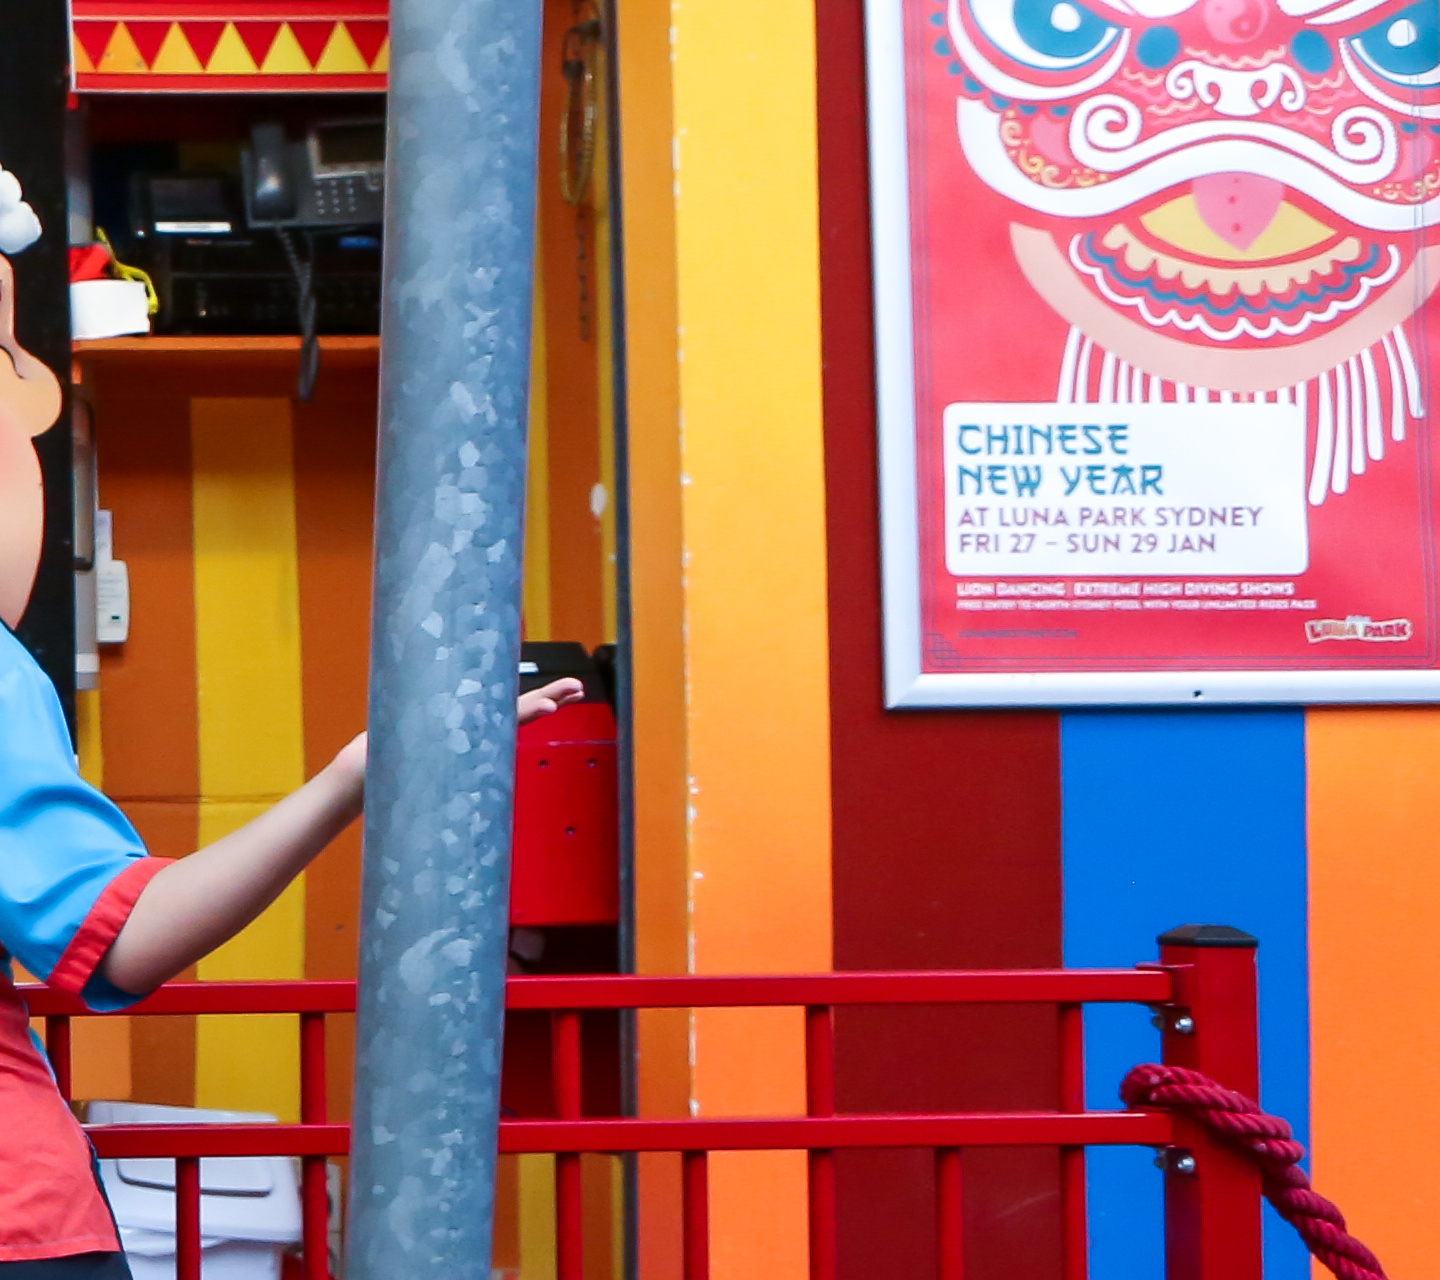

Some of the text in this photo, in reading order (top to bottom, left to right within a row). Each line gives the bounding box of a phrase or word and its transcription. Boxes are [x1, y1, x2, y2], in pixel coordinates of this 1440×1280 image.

[956, 423, 1130, 457] CHINESE
[956, 463, 1165, 498] NEW YEAR
[957, 506, 1264, 527] AT LUNA PARK SYDNEY
[958, 533, 1000, 554] FRI
[1008, 533, 1037, 554] 27
[1066, 533, 1121, 554] SUN
[1130, 533, 1159, 554] 29
[1166, 533, 1217, 554] JAN
[996, 582, 1067, 597] DANCING
[1143, 582, 1183, 596] HIGH
[1184, 582, 1239, 596] DIVING
[1240, 582, 1295, 596] SHOWS
[1308, 622, 1409, 639] LUNA PARK
